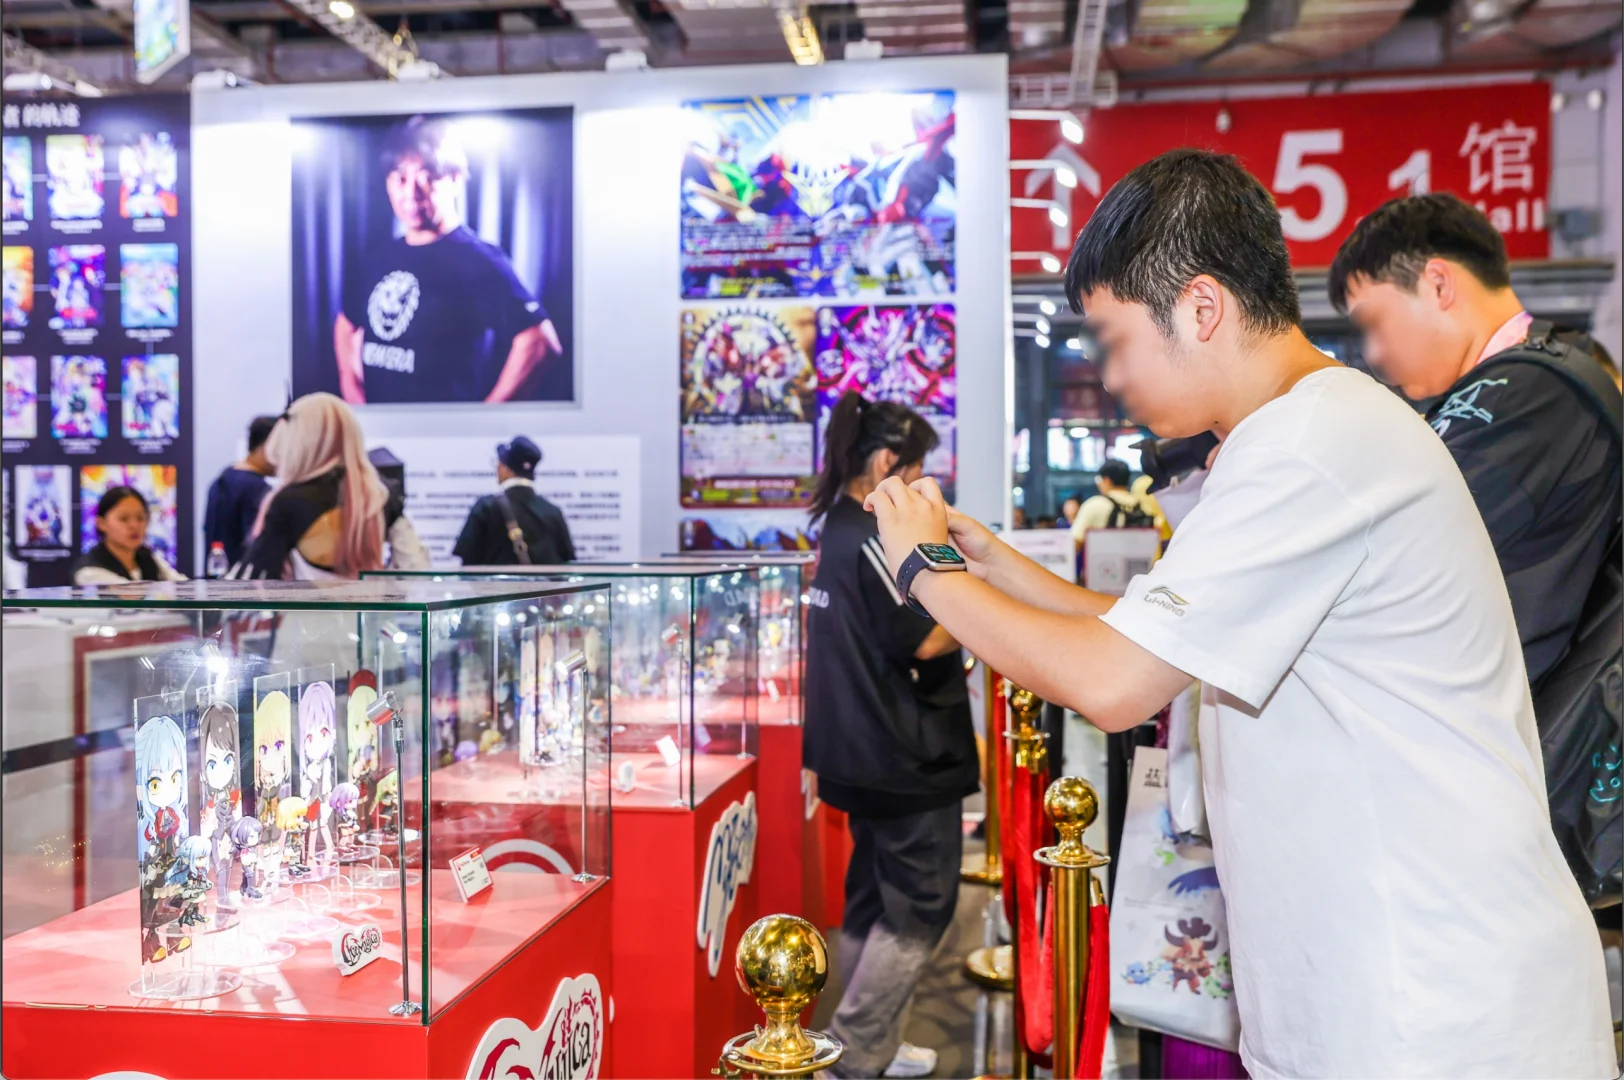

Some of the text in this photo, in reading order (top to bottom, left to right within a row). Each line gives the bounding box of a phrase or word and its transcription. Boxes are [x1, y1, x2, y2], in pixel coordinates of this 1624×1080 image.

[1458, 119, 1538, 194] 馆
[1271, 128, 1348, 242] 5
[1475, 199, 1544, 233] all
[1143, 593, 1186, 618] LI-NING
